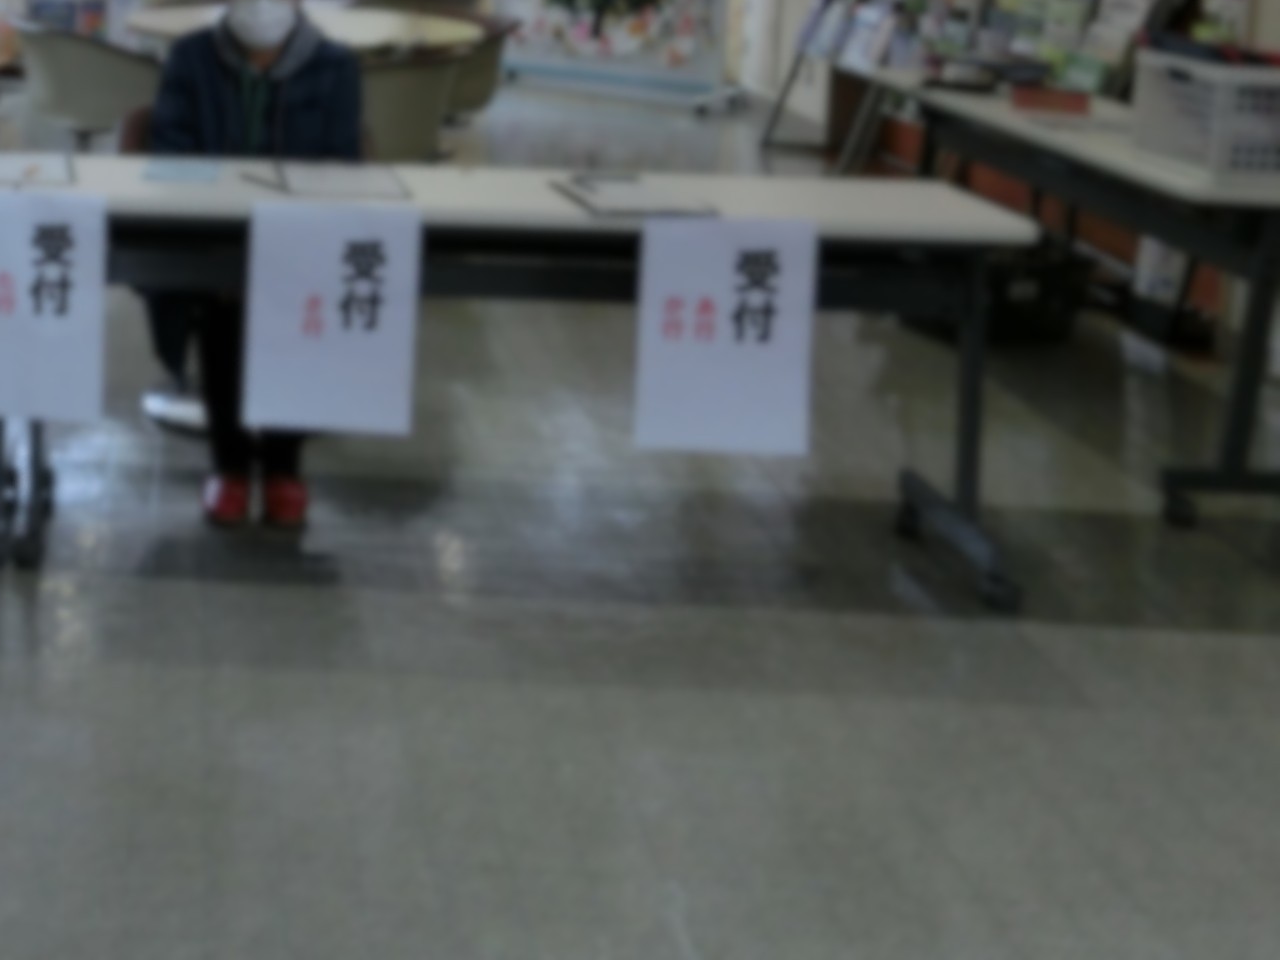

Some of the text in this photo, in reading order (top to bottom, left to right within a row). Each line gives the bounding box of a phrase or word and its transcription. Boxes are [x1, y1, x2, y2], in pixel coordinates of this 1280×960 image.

[31, 223, 74, 316] 受付
[340, 240, 386, 330] 受付
[733, 250, 779, 342] 受付
